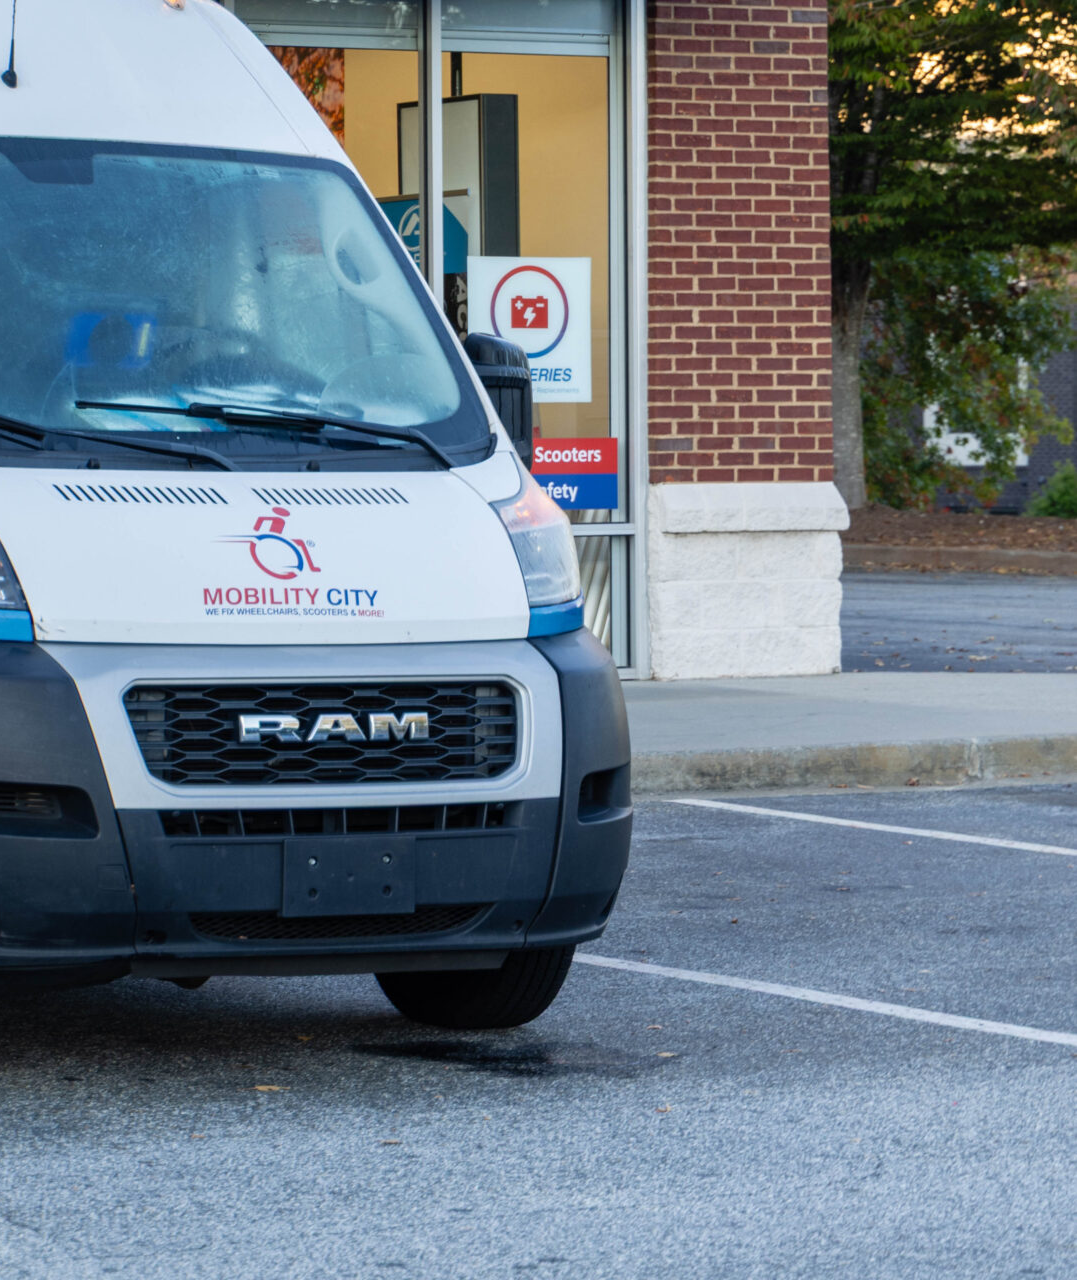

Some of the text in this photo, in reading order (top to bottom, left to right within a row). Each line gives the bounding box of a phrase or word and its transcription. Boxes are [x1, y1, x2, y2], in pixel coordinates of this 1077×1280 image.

[534, 446, 602, 463] Scooters
[203, 587, 378, 607] MOBILITY CITY
[205, 607, 385, 618] WE FIX WHEELCHAIRS, SCOOTERS & MORE!
[238, 711, 430, 744] RAM
